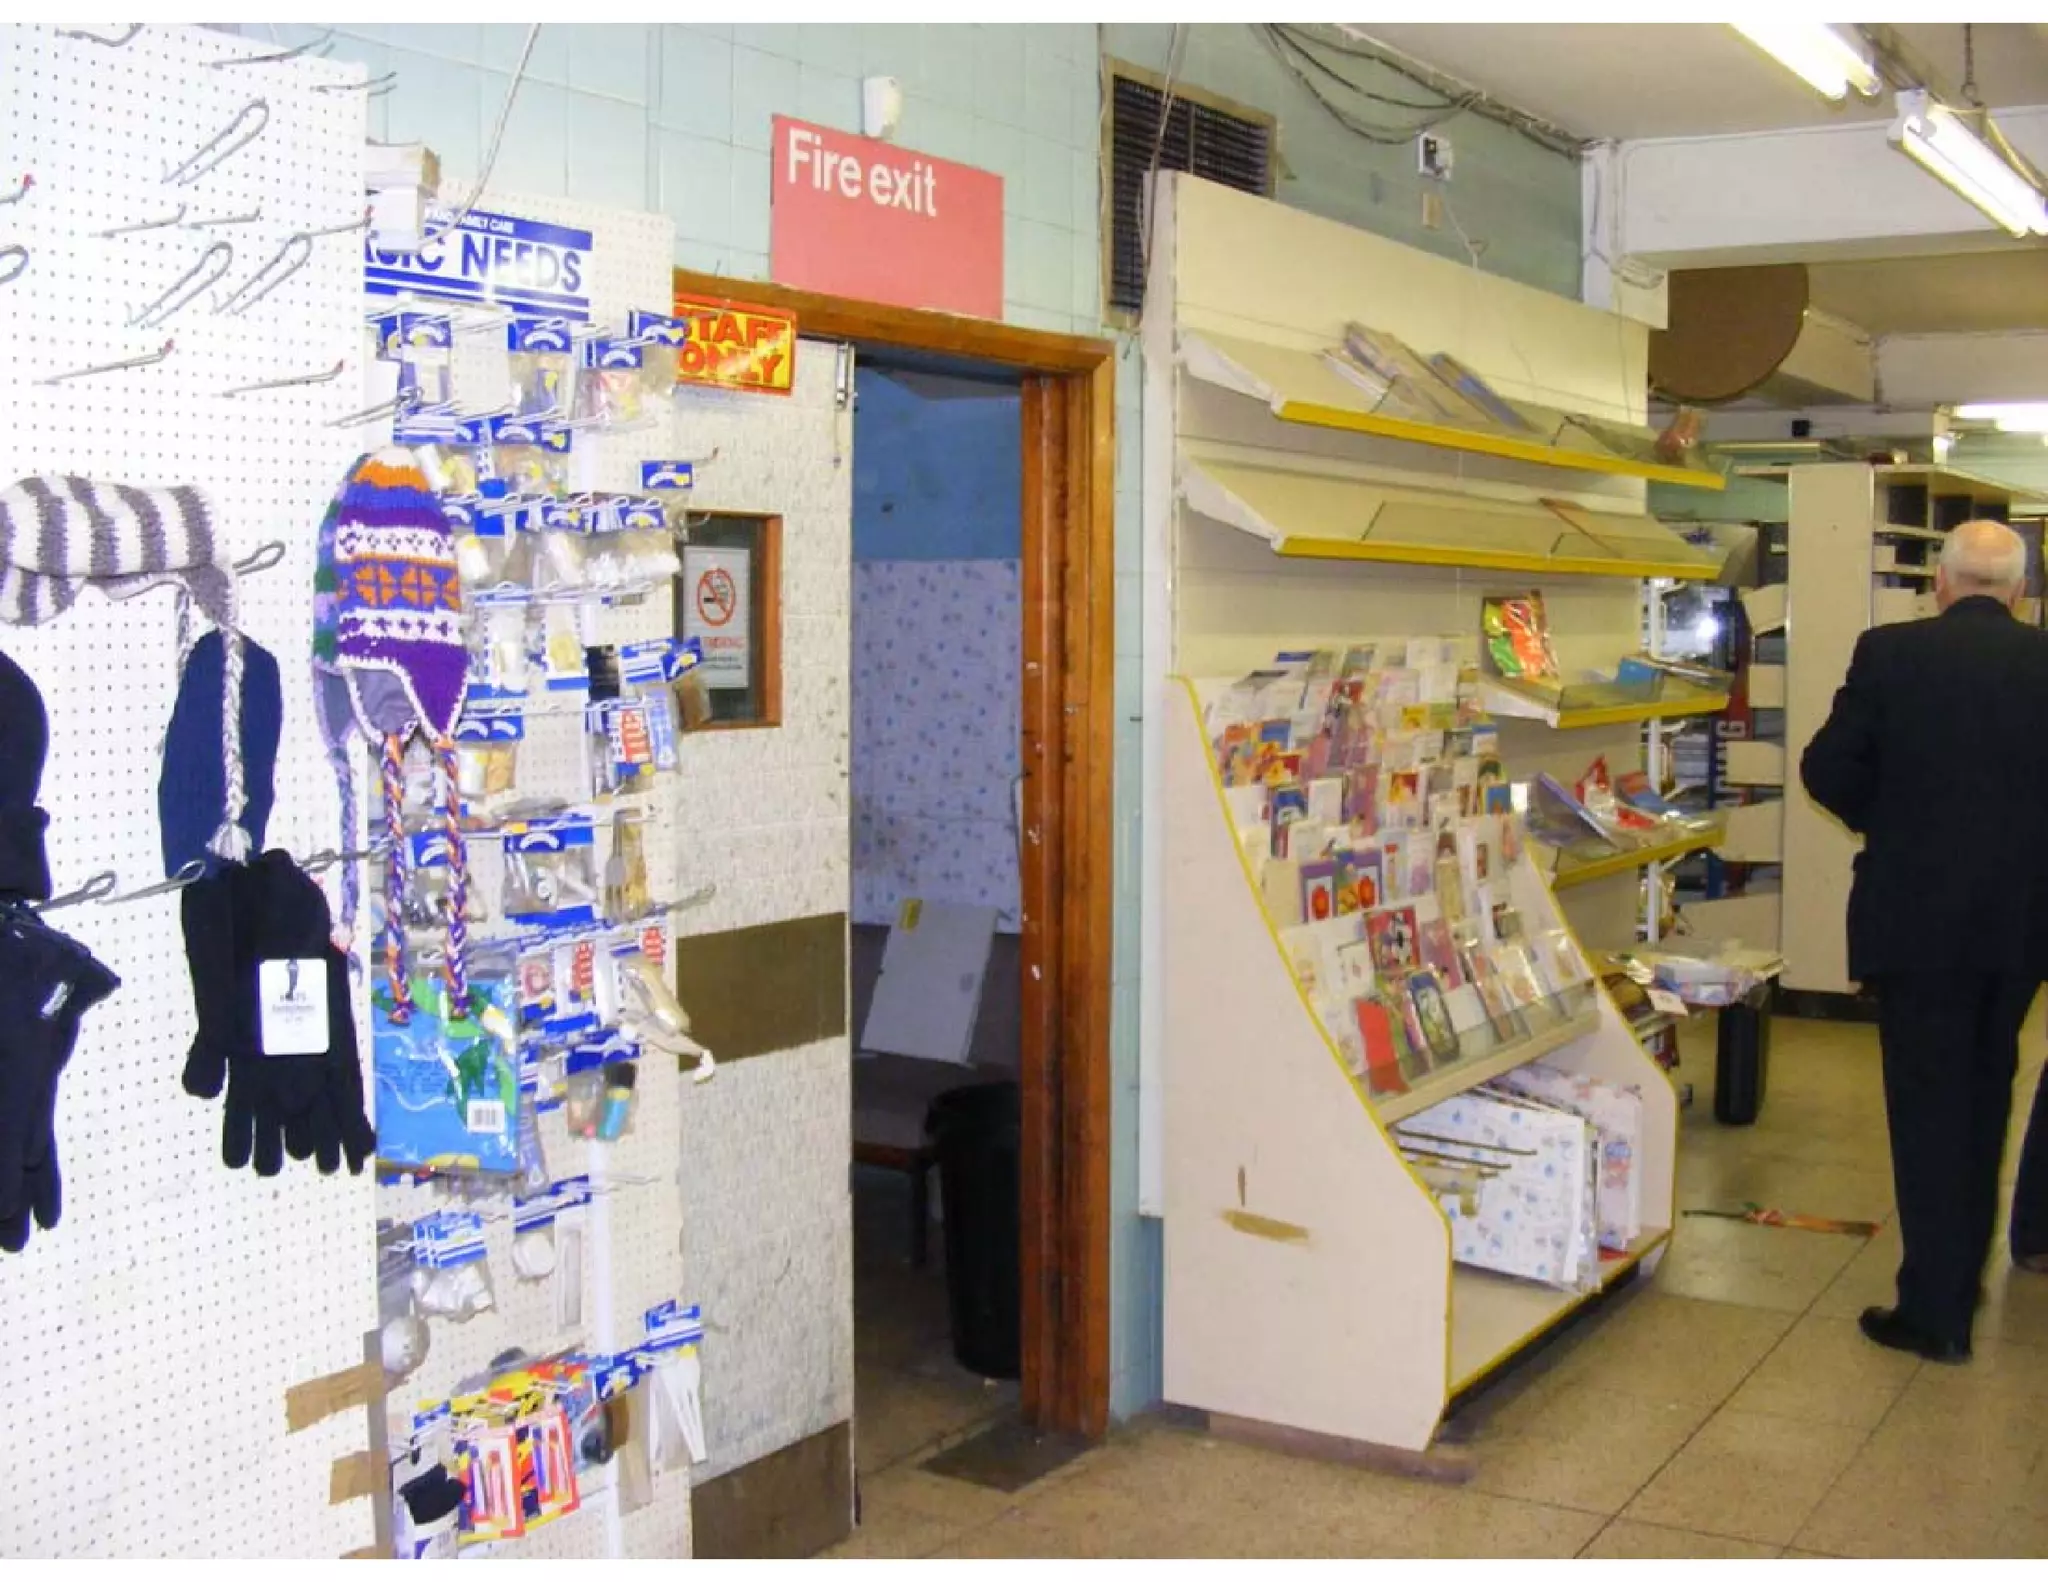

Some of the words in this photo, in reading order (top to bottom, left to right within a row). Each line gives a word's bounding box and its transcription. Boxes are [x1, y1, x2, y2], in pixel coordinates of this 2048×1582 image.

[787, 127, 862, 198] Fire
[869, 160, 937, 217] exit
[461, 231, 582, 293] NEEDS
